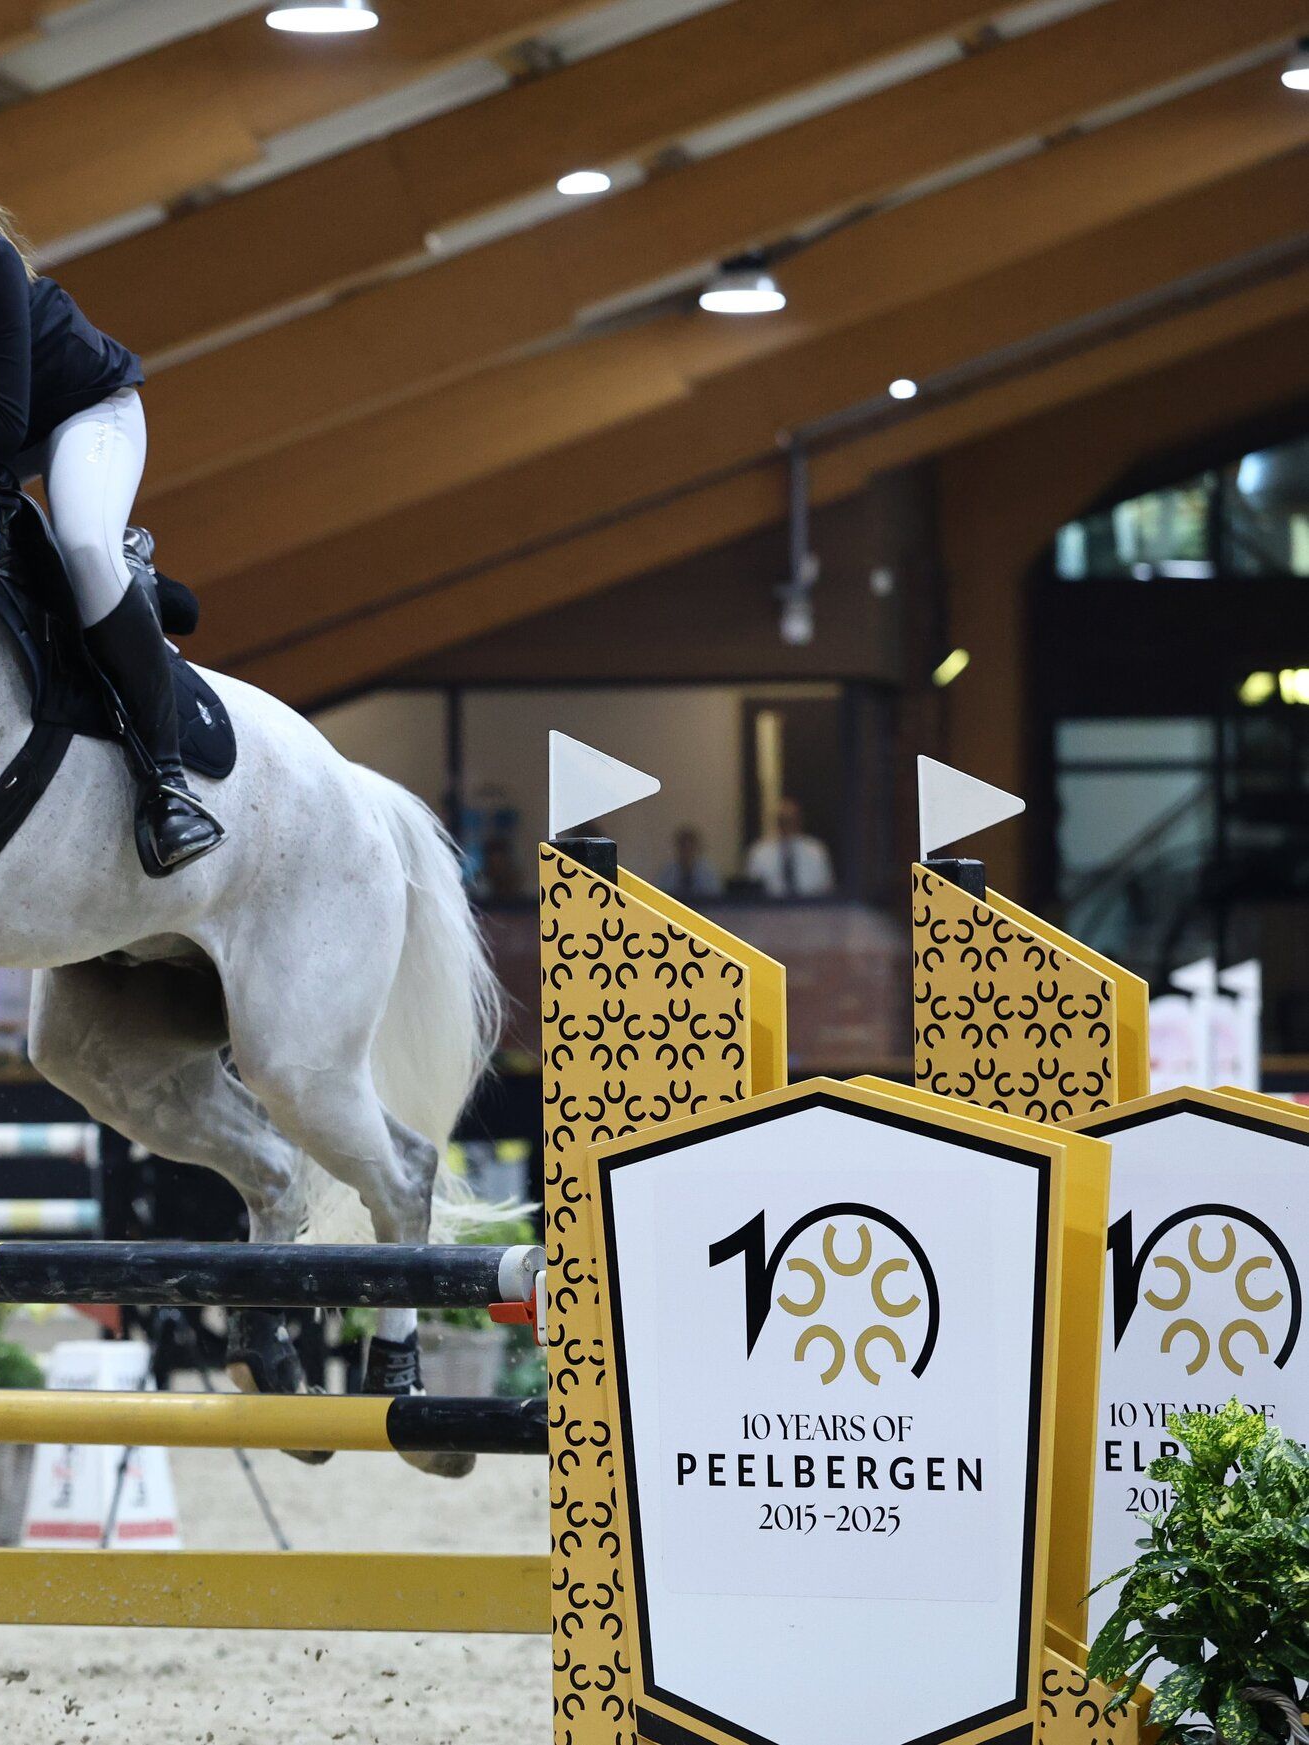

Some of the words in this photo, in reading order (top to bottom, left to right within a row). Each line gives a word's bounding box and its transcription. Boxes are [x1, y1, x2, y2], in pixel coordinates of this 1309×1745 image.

[741, 1413, 771, 1440] 10
[777, 1413, 866, 1442] YEARS
[872, 1414, 914, 1443] OF
[1109, 1402, 1138, 1428] 10
[676, 1452, 983, 1492] PEELBERGEN
